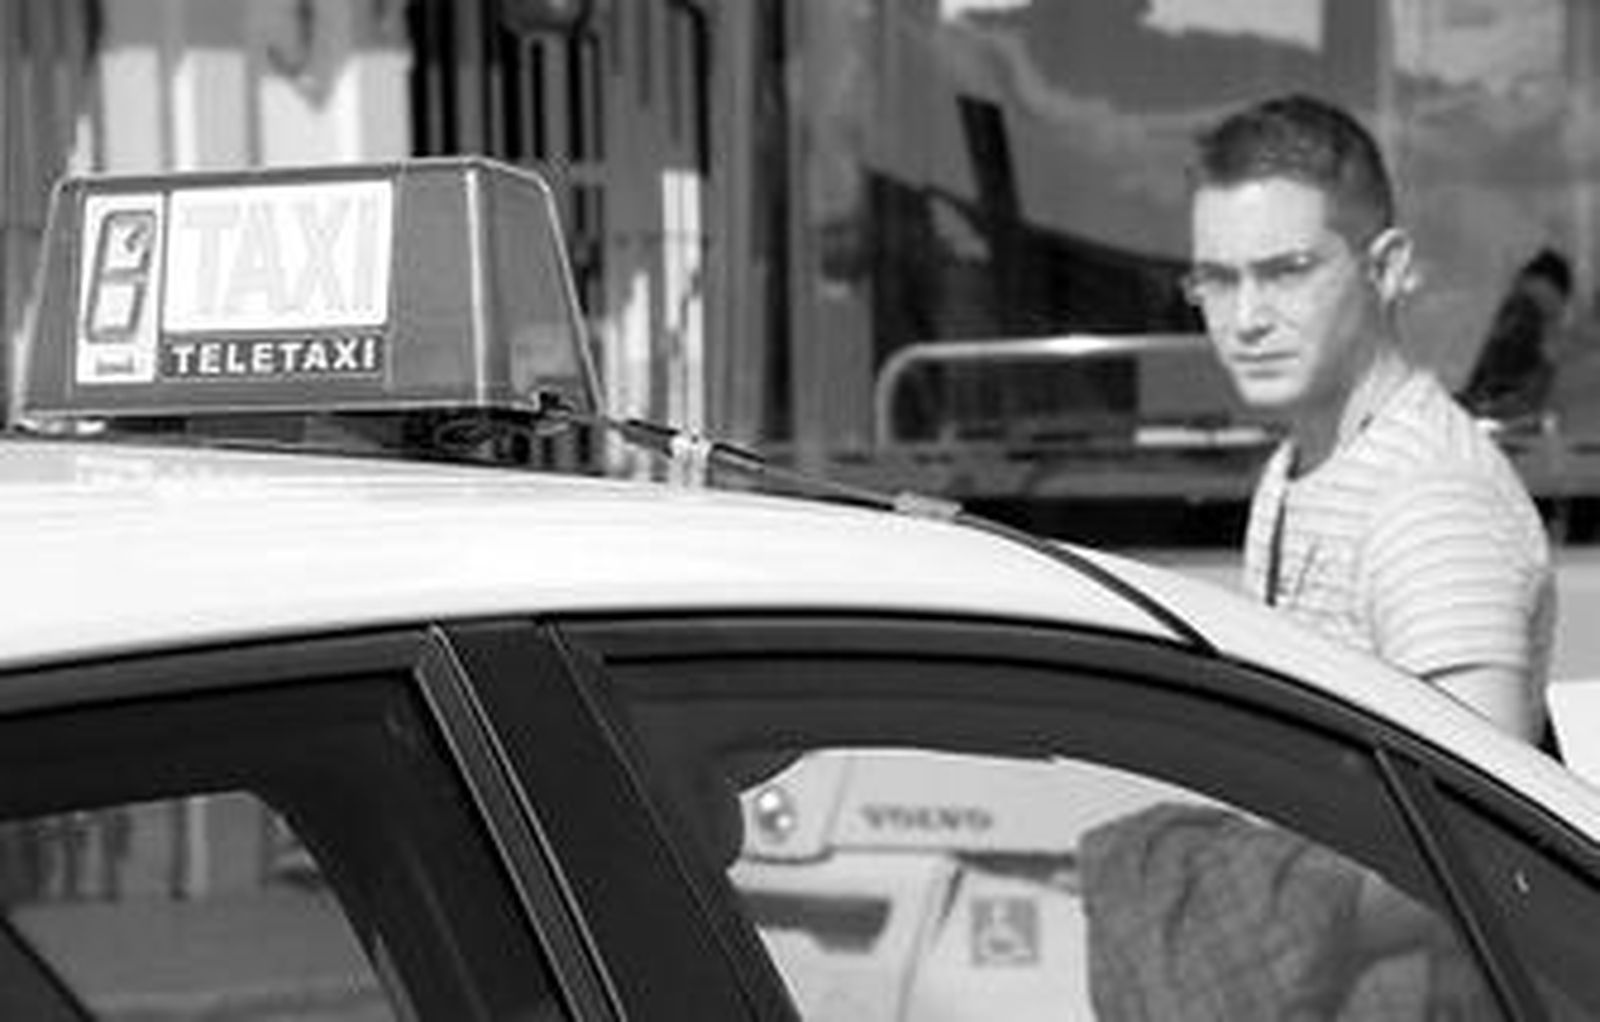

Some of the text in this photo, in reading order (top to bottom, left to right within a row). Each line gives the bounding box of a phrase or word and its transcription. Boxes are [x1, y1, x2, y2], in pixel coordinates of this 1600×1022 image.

[179, 196, 378, 316] TAXI
[171, 338, 377, 374] TELETAXI
[861, 804, 994, 832] VOLVO
